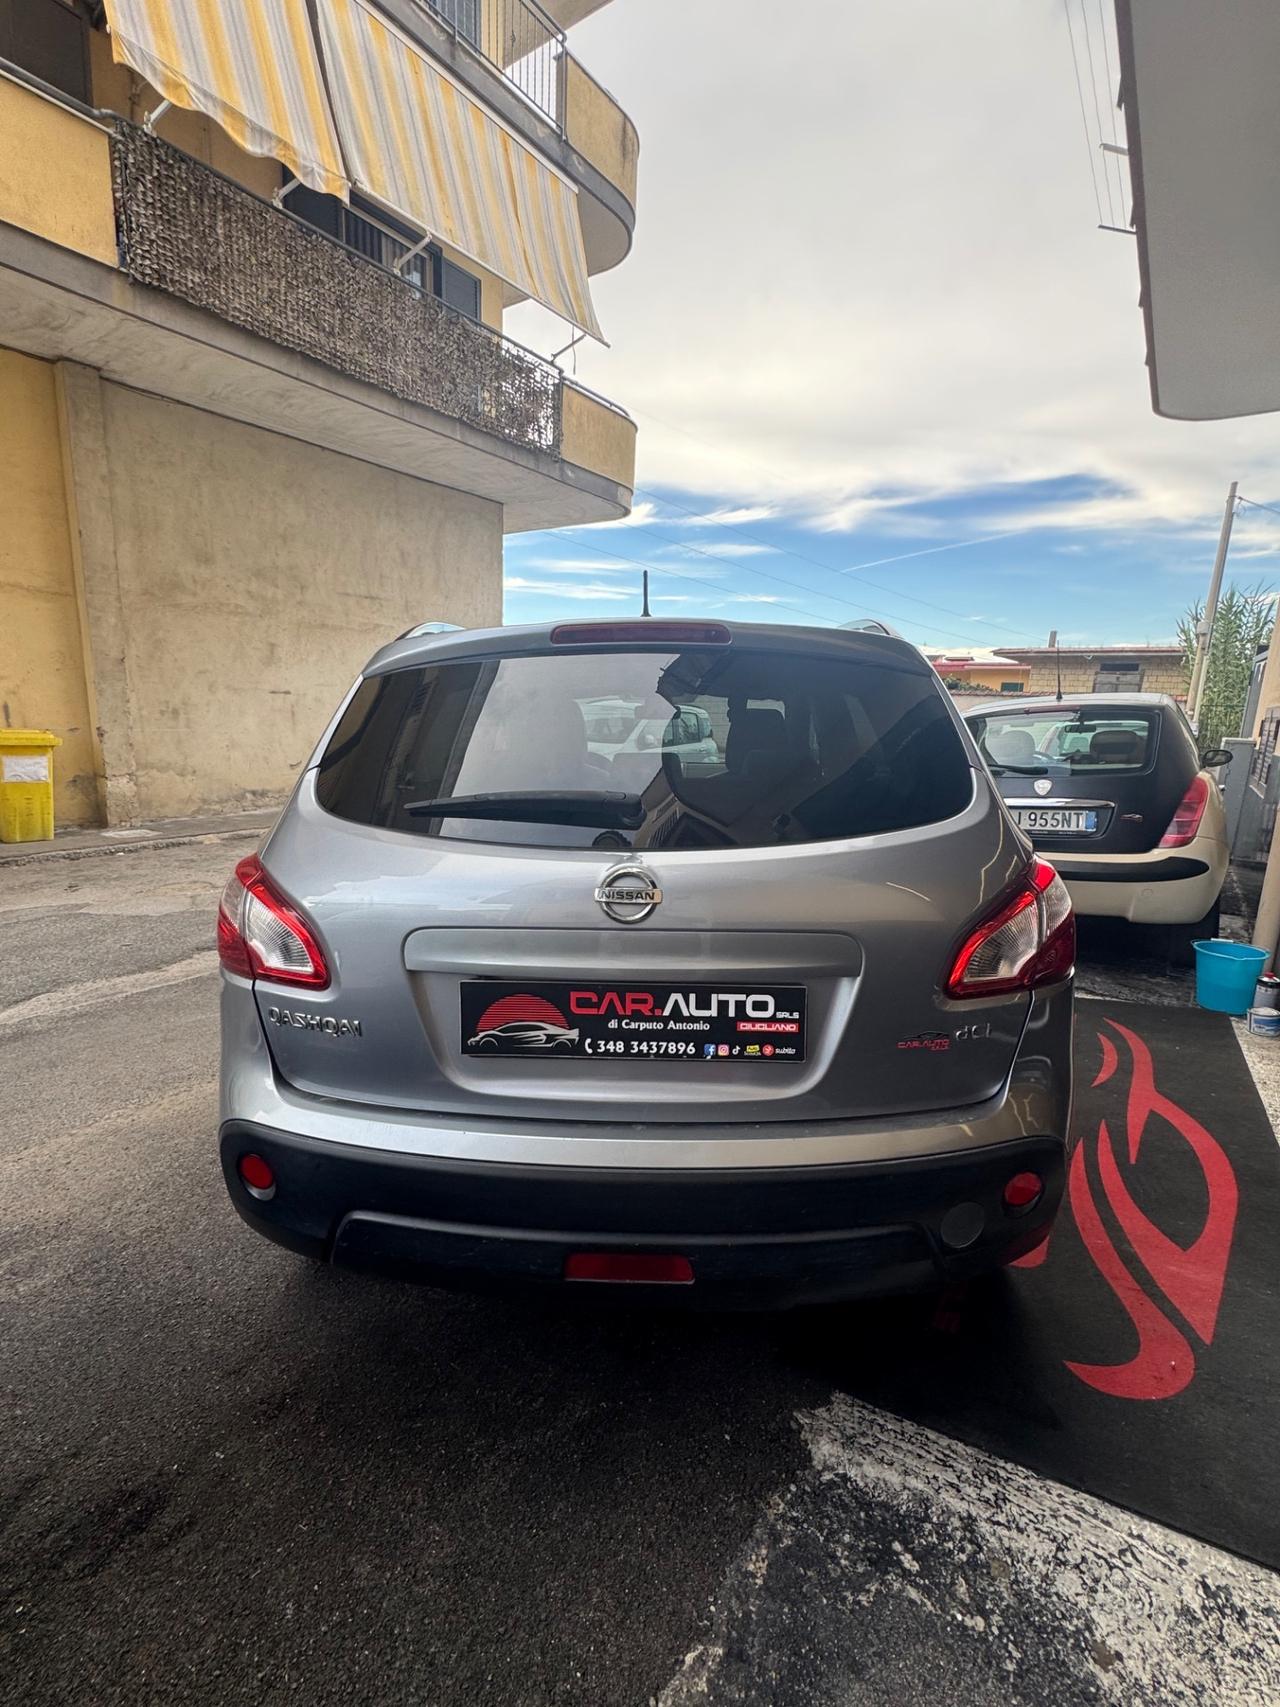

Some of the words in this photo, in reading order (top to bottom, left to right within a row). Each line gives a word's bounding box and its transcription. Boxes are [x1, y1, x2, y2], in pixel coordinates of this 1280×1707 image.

[600, 890, 655, 901] NISSAN
[269, 1006, 362, 1037] QASHQAI
[608, 1019, 618, 1029] di
[621, 1020, 664, 1031] Carputo
[667, 1020, 710, 1030] Antonio
[740, 1022, 797, 1031] GIUGLIANO
[597, 1040, 625, 1053] 348
[630, 1041, 696, 1055] 3437896
